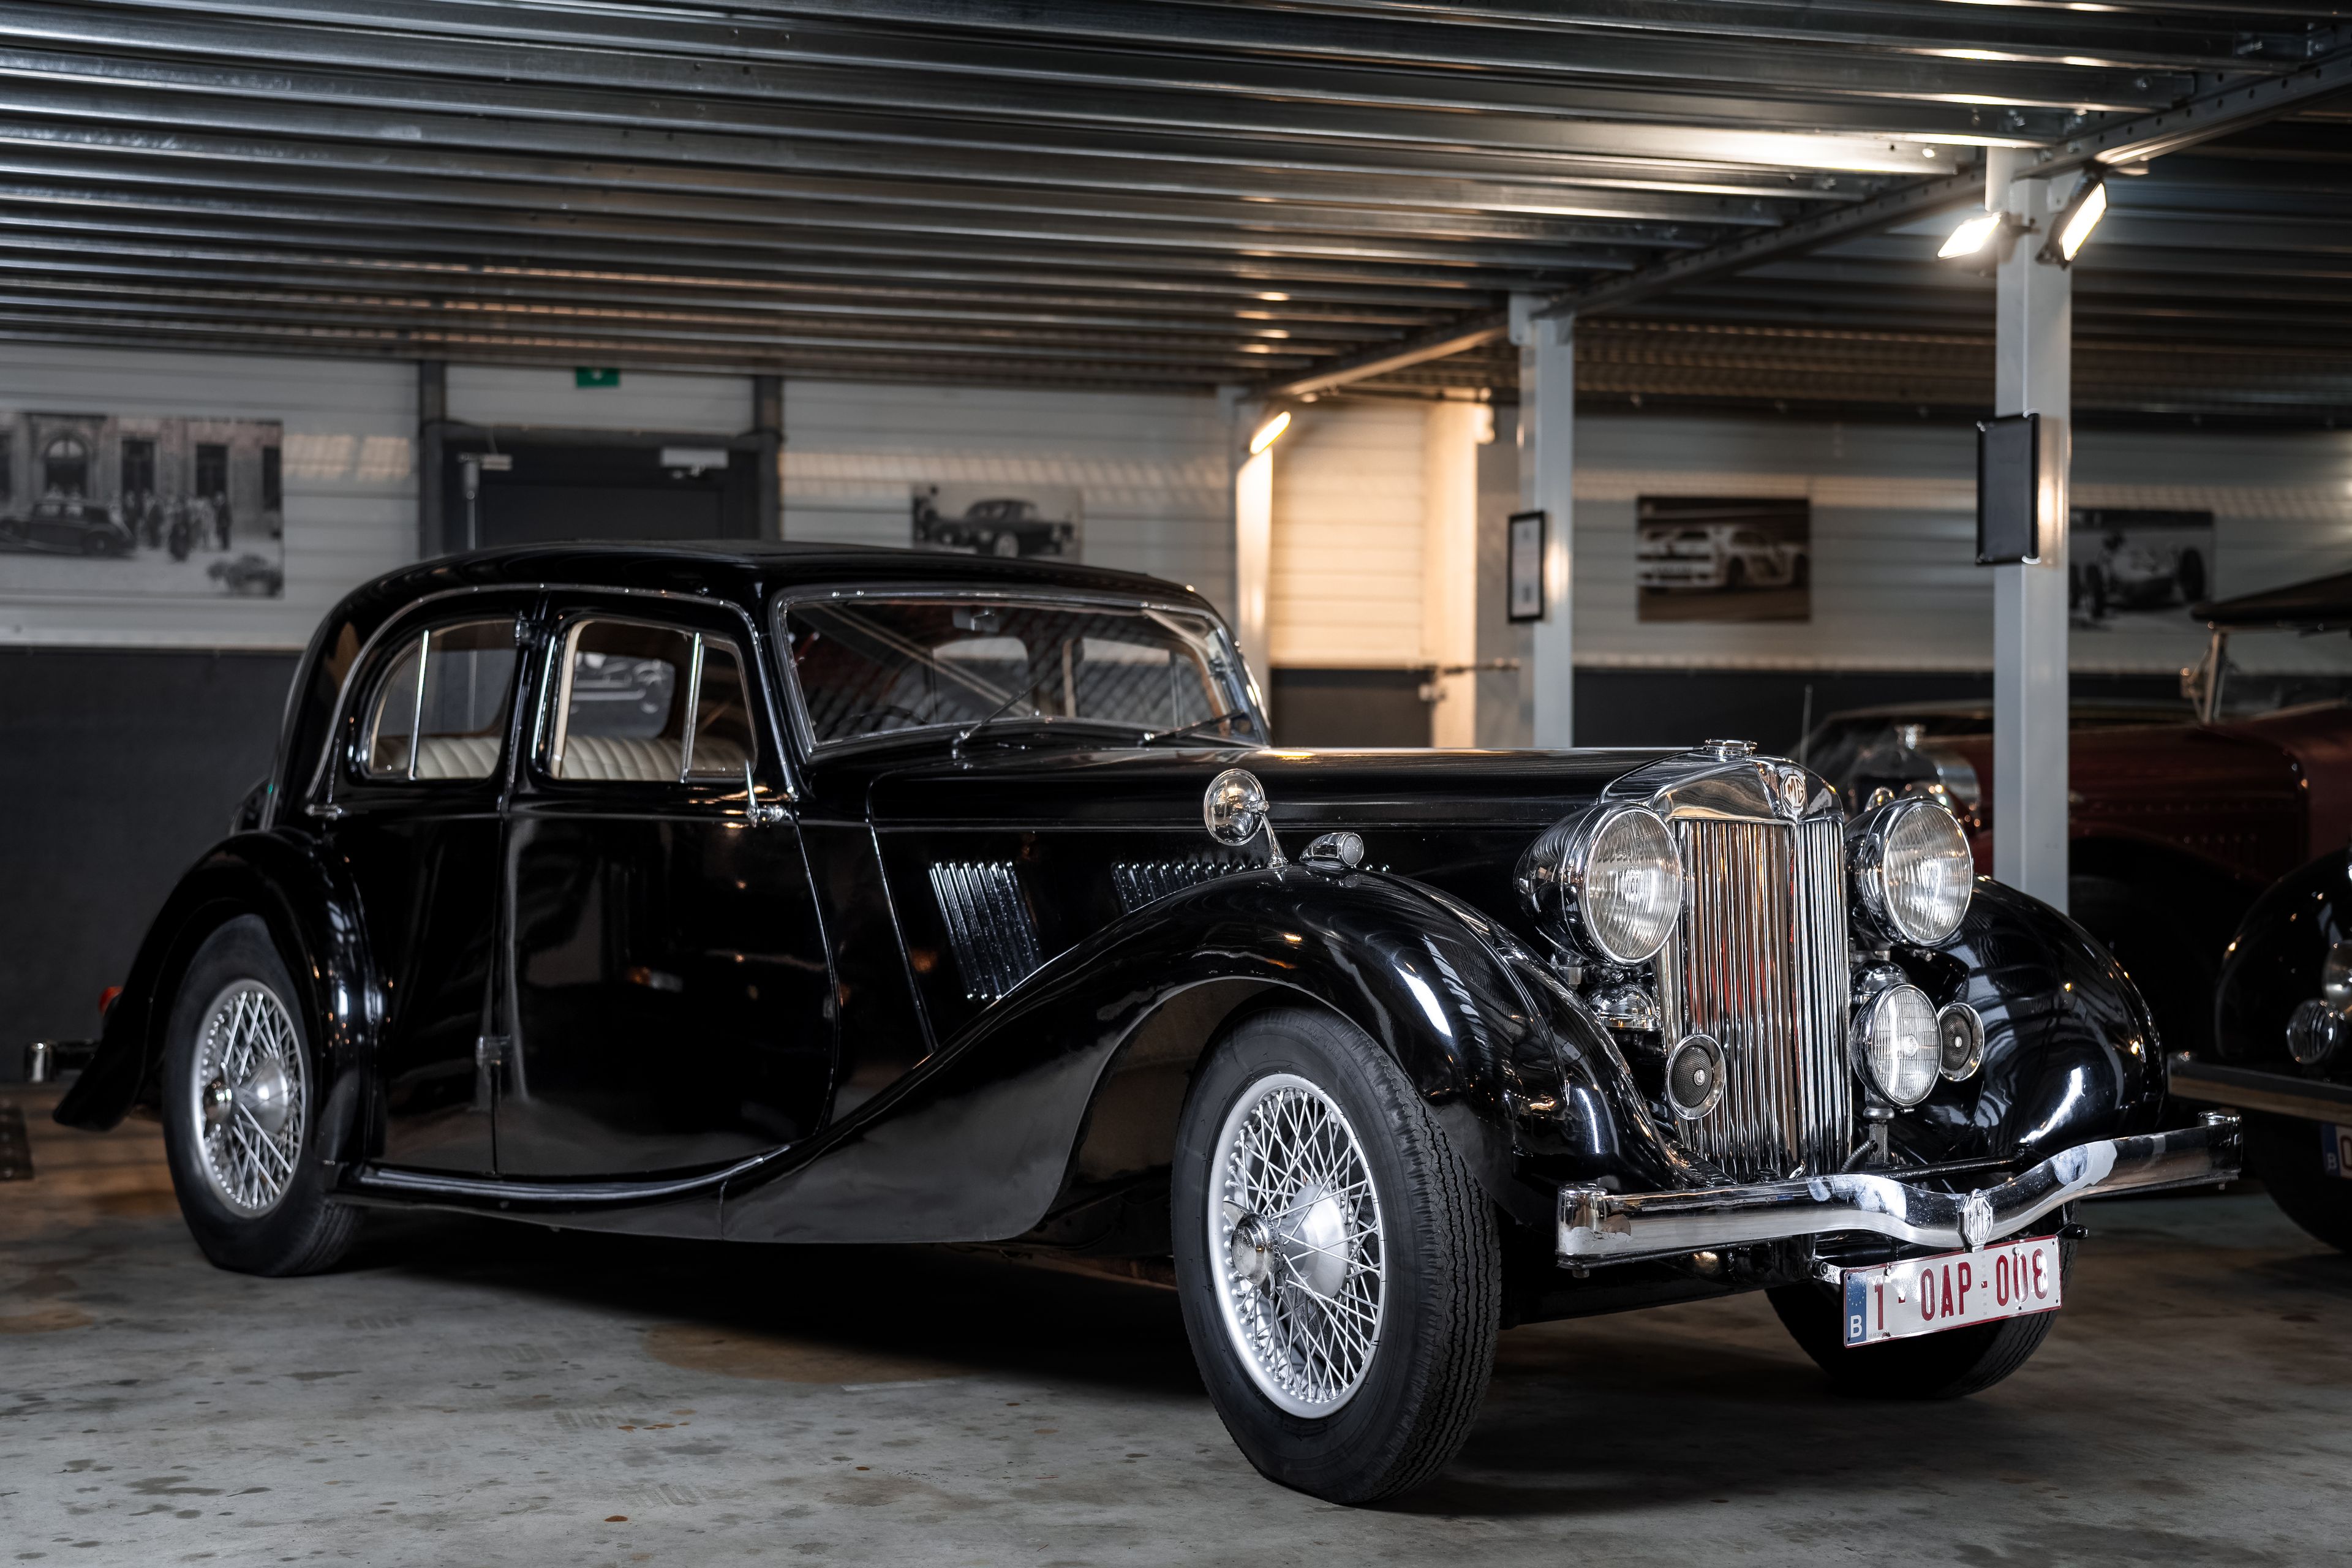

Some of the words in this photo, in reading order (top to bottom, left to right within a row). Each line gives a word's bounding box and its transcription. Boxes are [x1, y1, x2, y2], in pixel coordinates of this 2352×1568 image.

[1785, 776, 1805, 805] MG
[1966, 1199, 1992, 1243] MG
[1850, 1314, 1862, 1338] B
